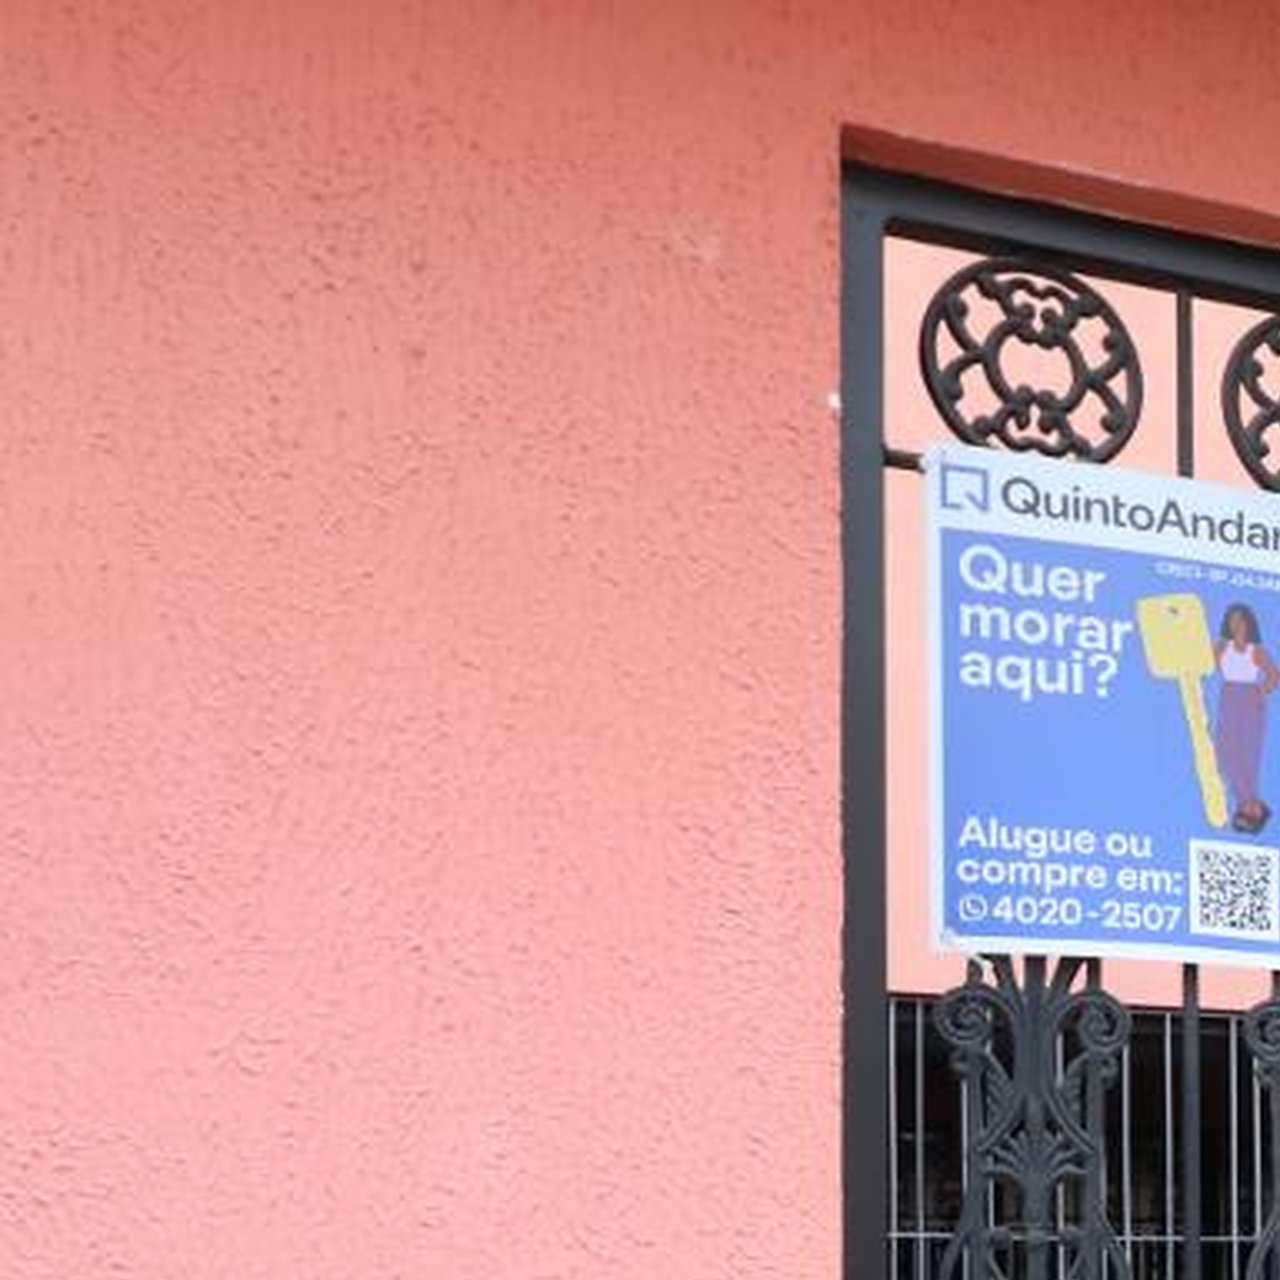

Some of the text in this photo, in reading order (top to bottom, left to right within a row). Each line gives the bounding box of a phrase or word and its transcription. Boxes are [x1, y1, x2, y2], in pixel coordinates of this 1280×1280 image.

[959, 545, 1104, 602] Quer
[960, 603, 1133, 653] morar
[959, 650, 1118, 700] aqui?
[959, 817, 1152, 858] Alugue ou
[957, 859, 1185, 895] compre em:
[992, 896, 1182, 931] 4020-2507
